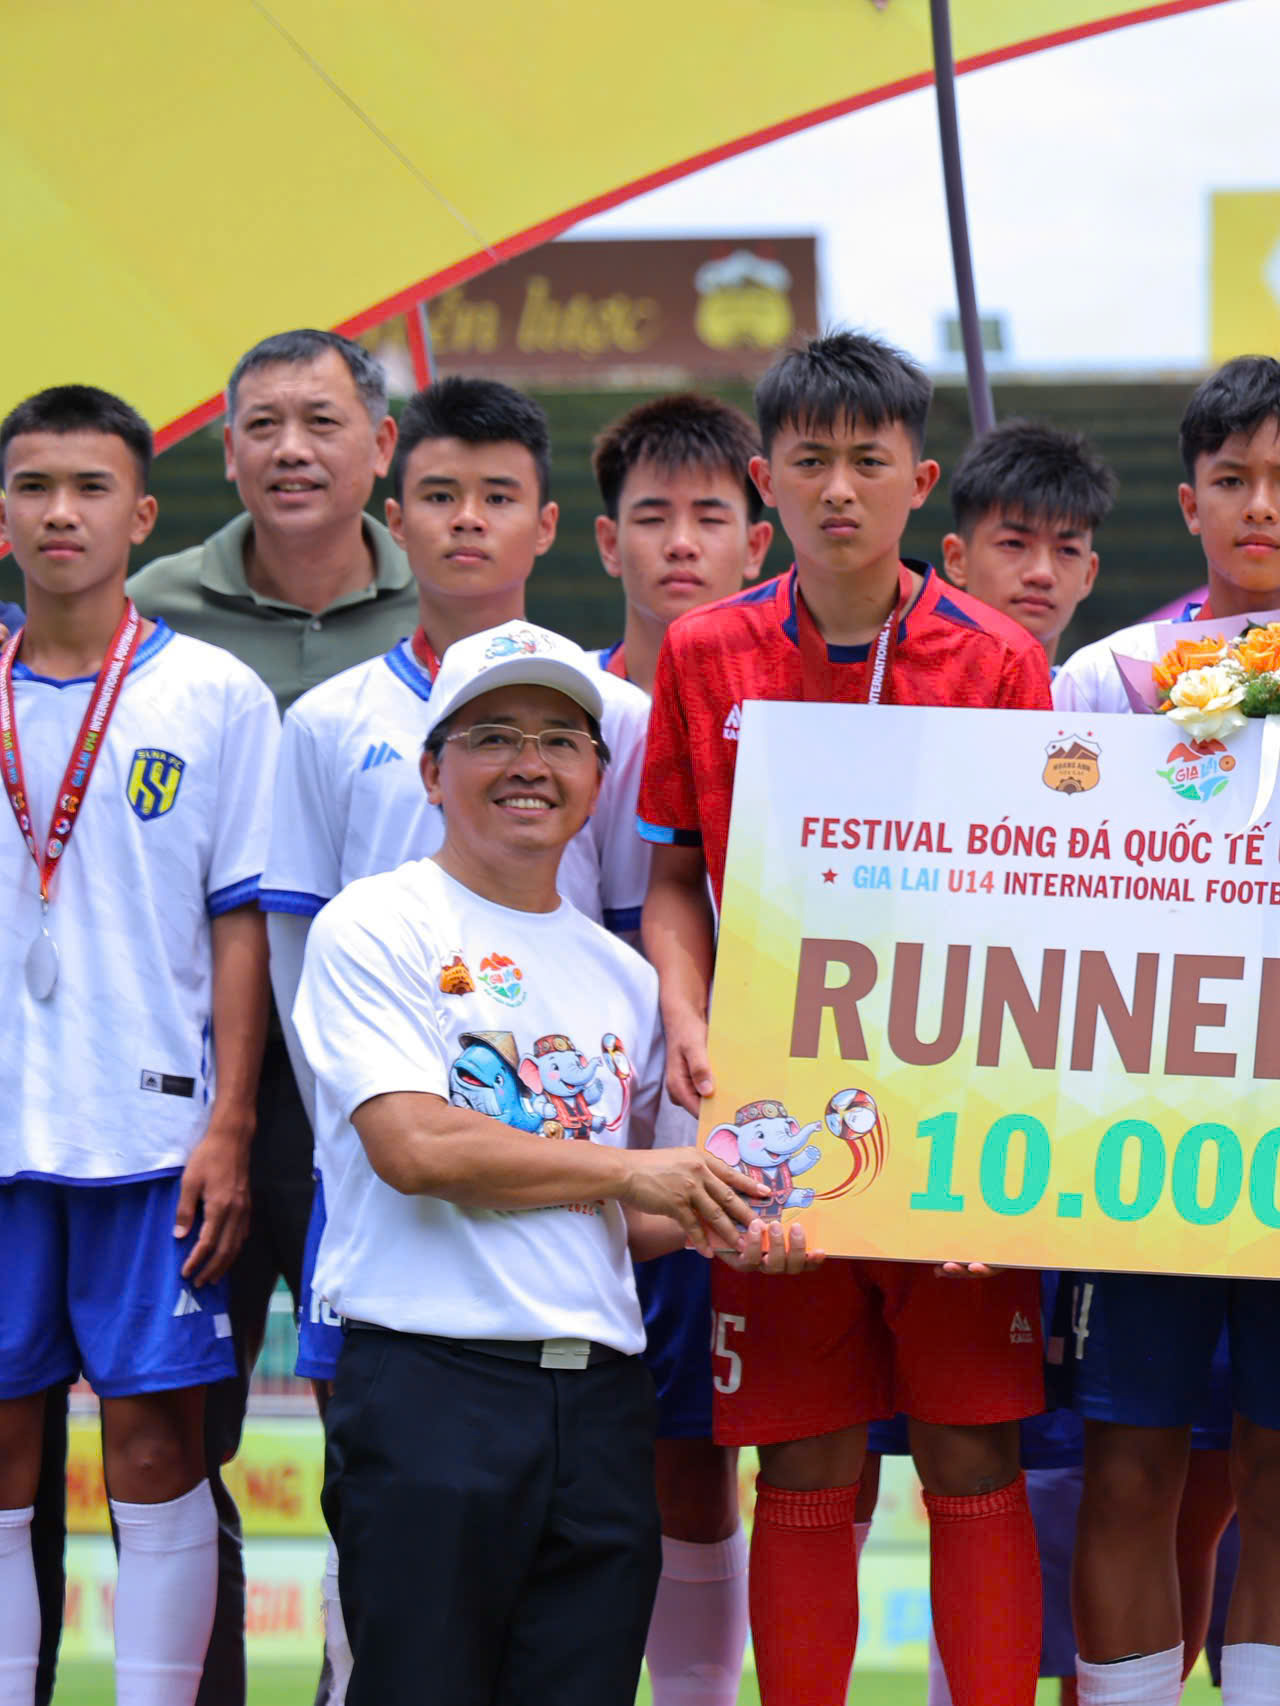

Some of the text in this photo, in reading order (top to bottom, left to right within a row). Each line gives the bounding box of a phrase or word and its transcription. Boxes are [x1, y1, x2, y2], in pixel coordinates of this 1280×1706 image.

[89, 660, 125, 733] INTERNATIONAL
[868, 629, 890, 705] NTERNATIONAL
[1176, 766, 1199, 783] GIA
[800, 816, 953, 854] FESTIVAL
[967, 815, 1057, 858] BÓNG
[1068, 819, 1111, 861] ĐÁ
[1124, 819, 1212, 868] QUỐC
[1224, 821, 1272, 867] TẾ
[853, 865, 893, 890] GIA
[901, 867, 939, 893] LAI
[948, 870, 995, 895] U14
[1004, 872, 1195, 903] INTERNATIONAL
[711, 1306, 746, 1394] 5
